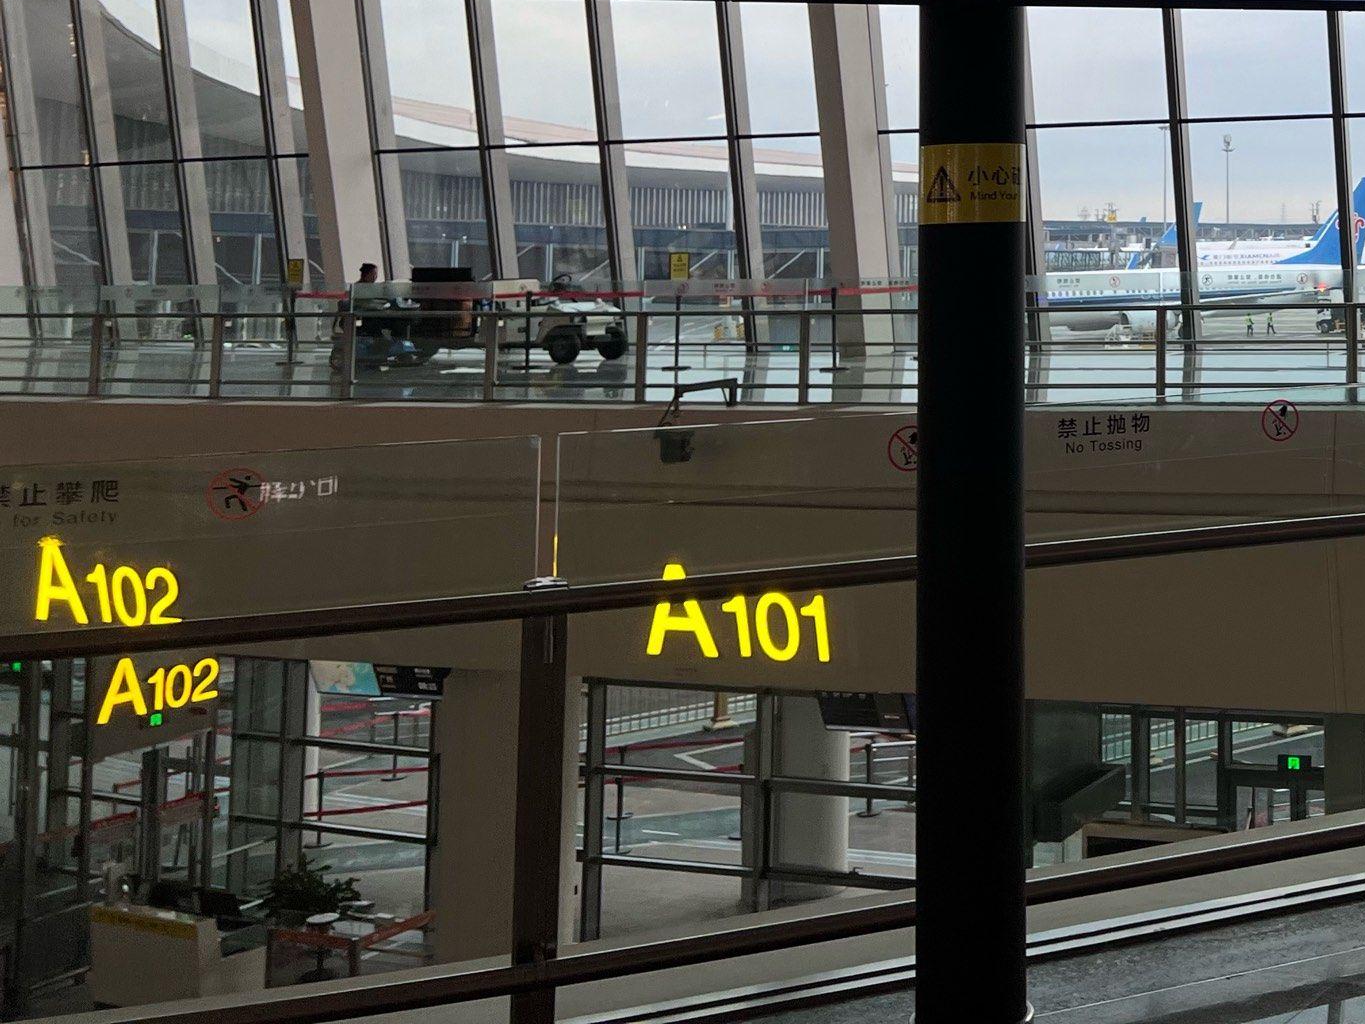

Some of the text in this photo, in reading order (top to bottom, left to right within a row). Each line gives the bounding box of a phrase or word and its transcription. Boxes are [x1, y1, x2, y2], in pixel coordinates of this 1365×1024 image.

[1058, 413, 1150, 439] 禁止抛物
[1066, 439, 1142, 454] No Tossing
[35, 536, 183, 627] A102
[646, 563, 831, 663] A101
[96, 657, 220, 725] A102
